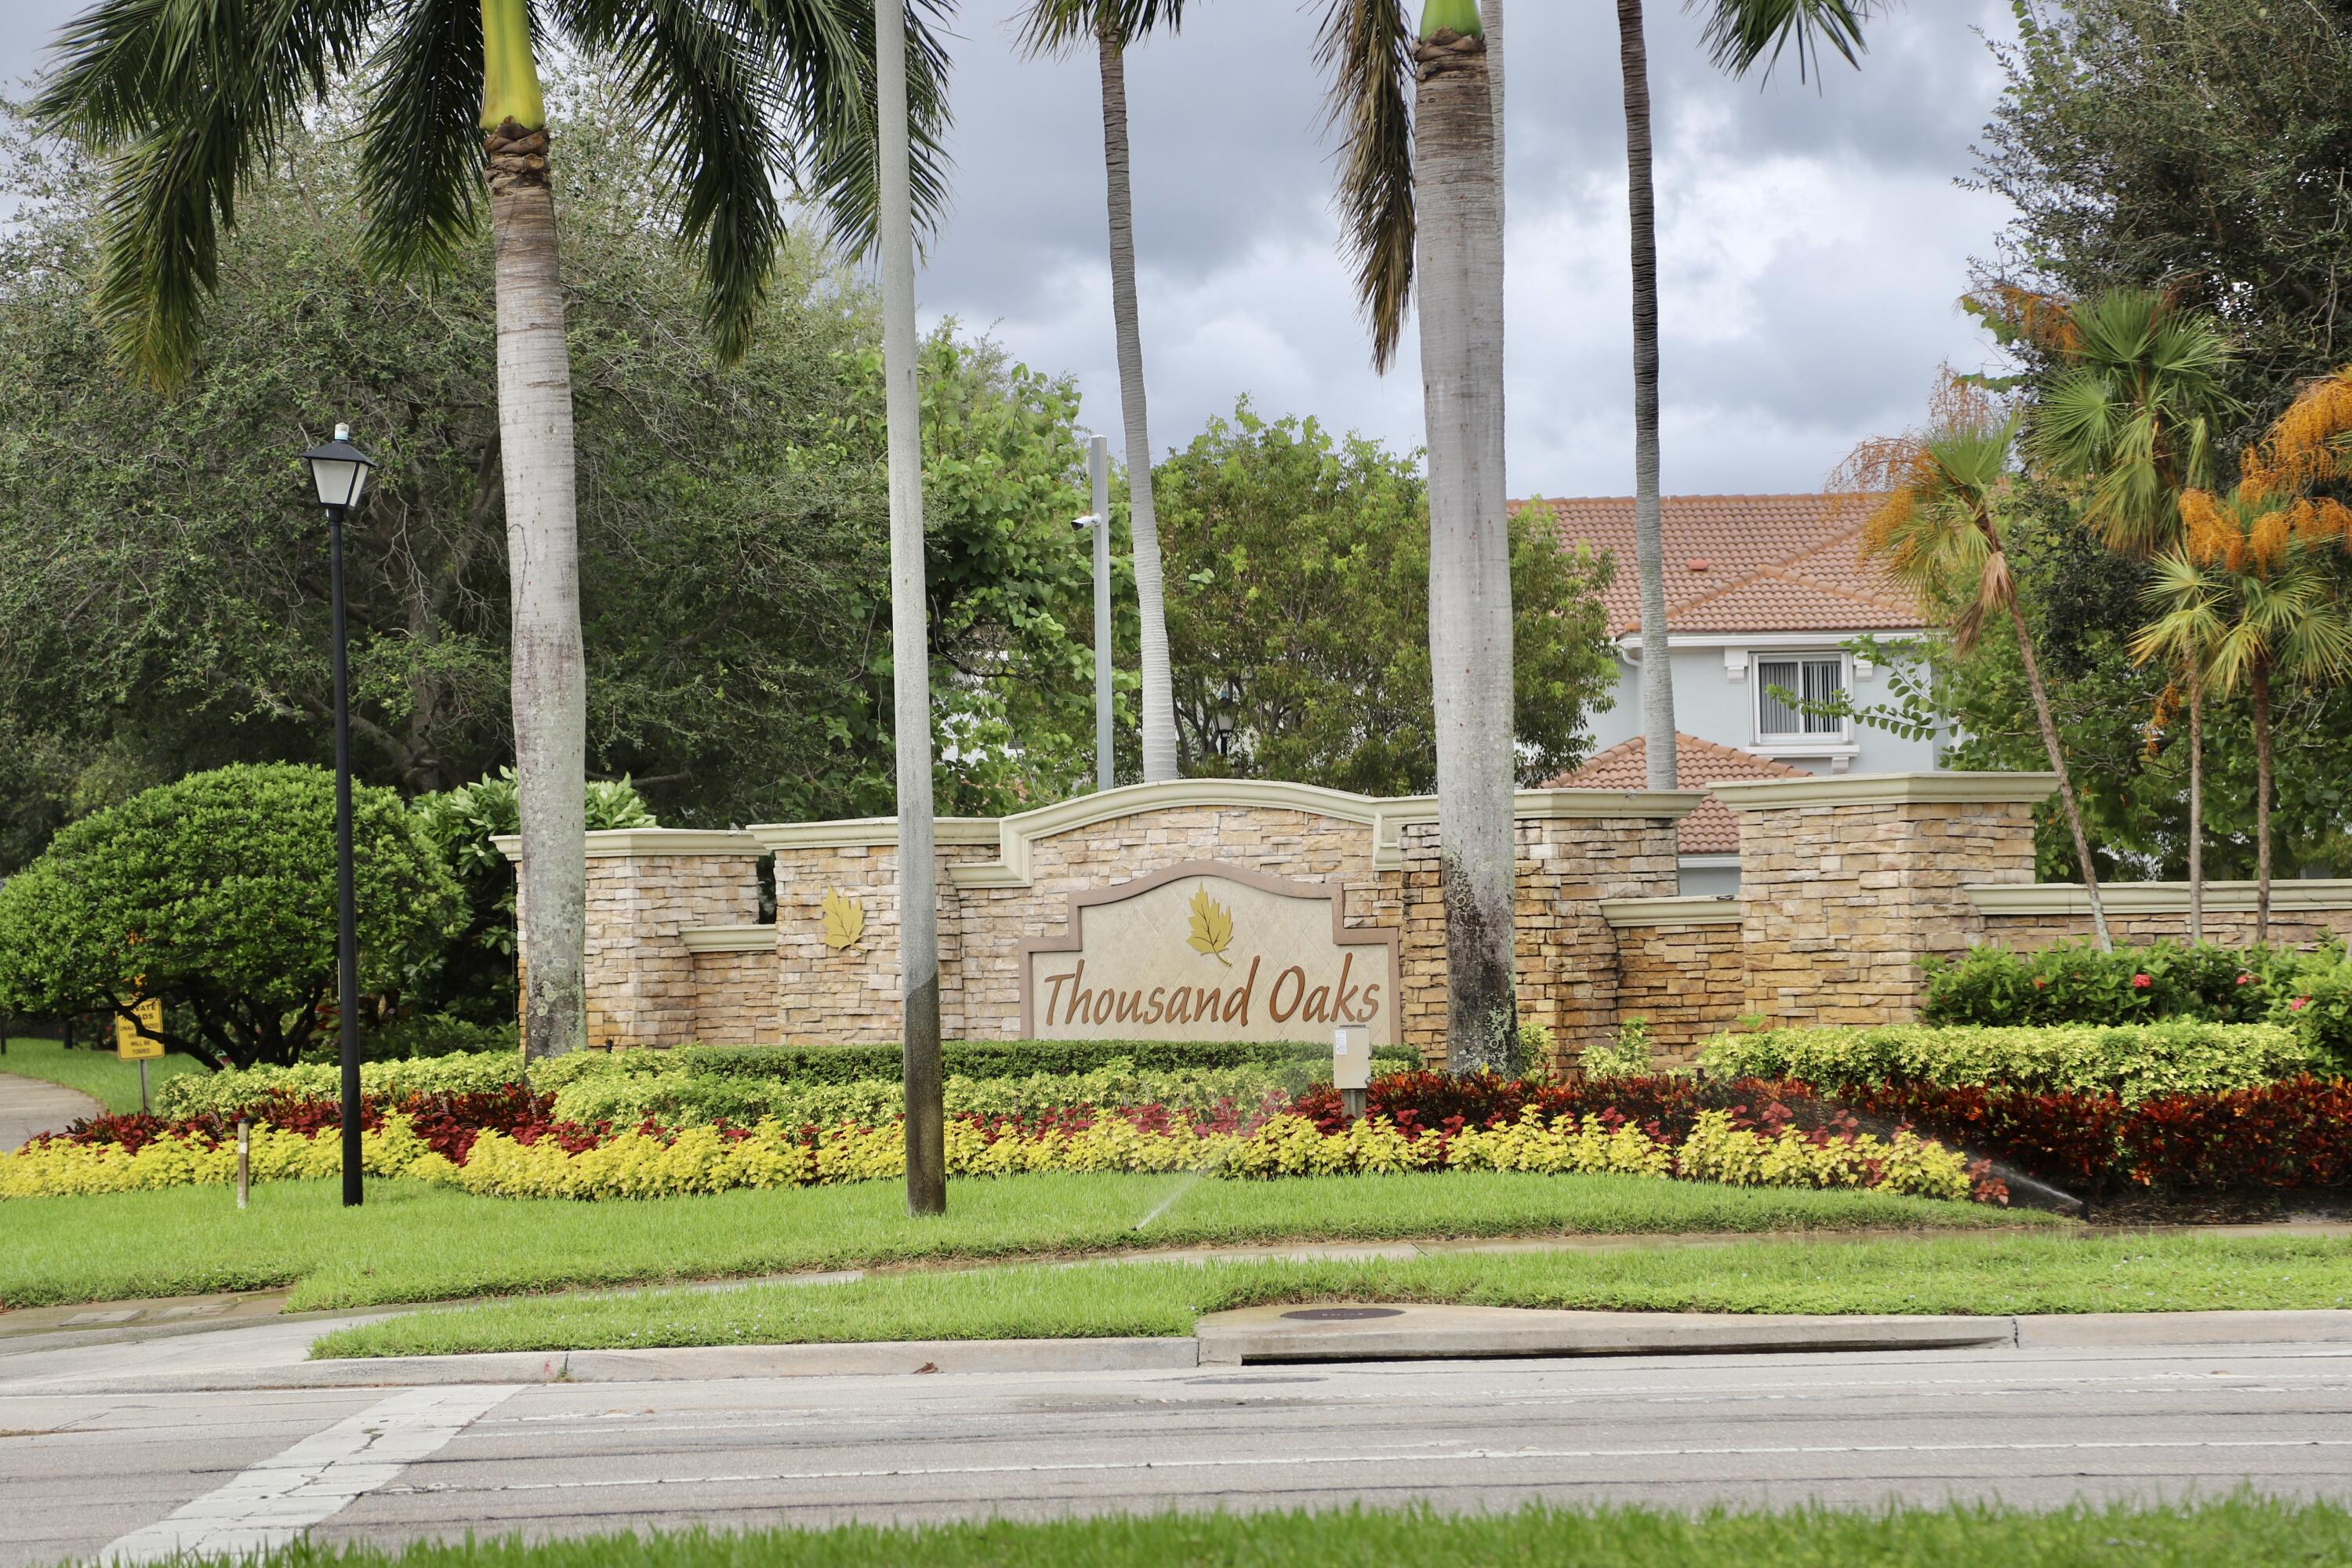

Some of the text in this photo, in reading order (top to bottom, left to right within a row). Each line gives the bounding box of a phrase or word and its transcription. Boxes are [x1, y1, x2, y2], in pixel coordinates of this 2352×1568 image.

[125, 1003, 157, 1011] VATE
[1044, 952, 1381, 1027] Thousand Oaks
